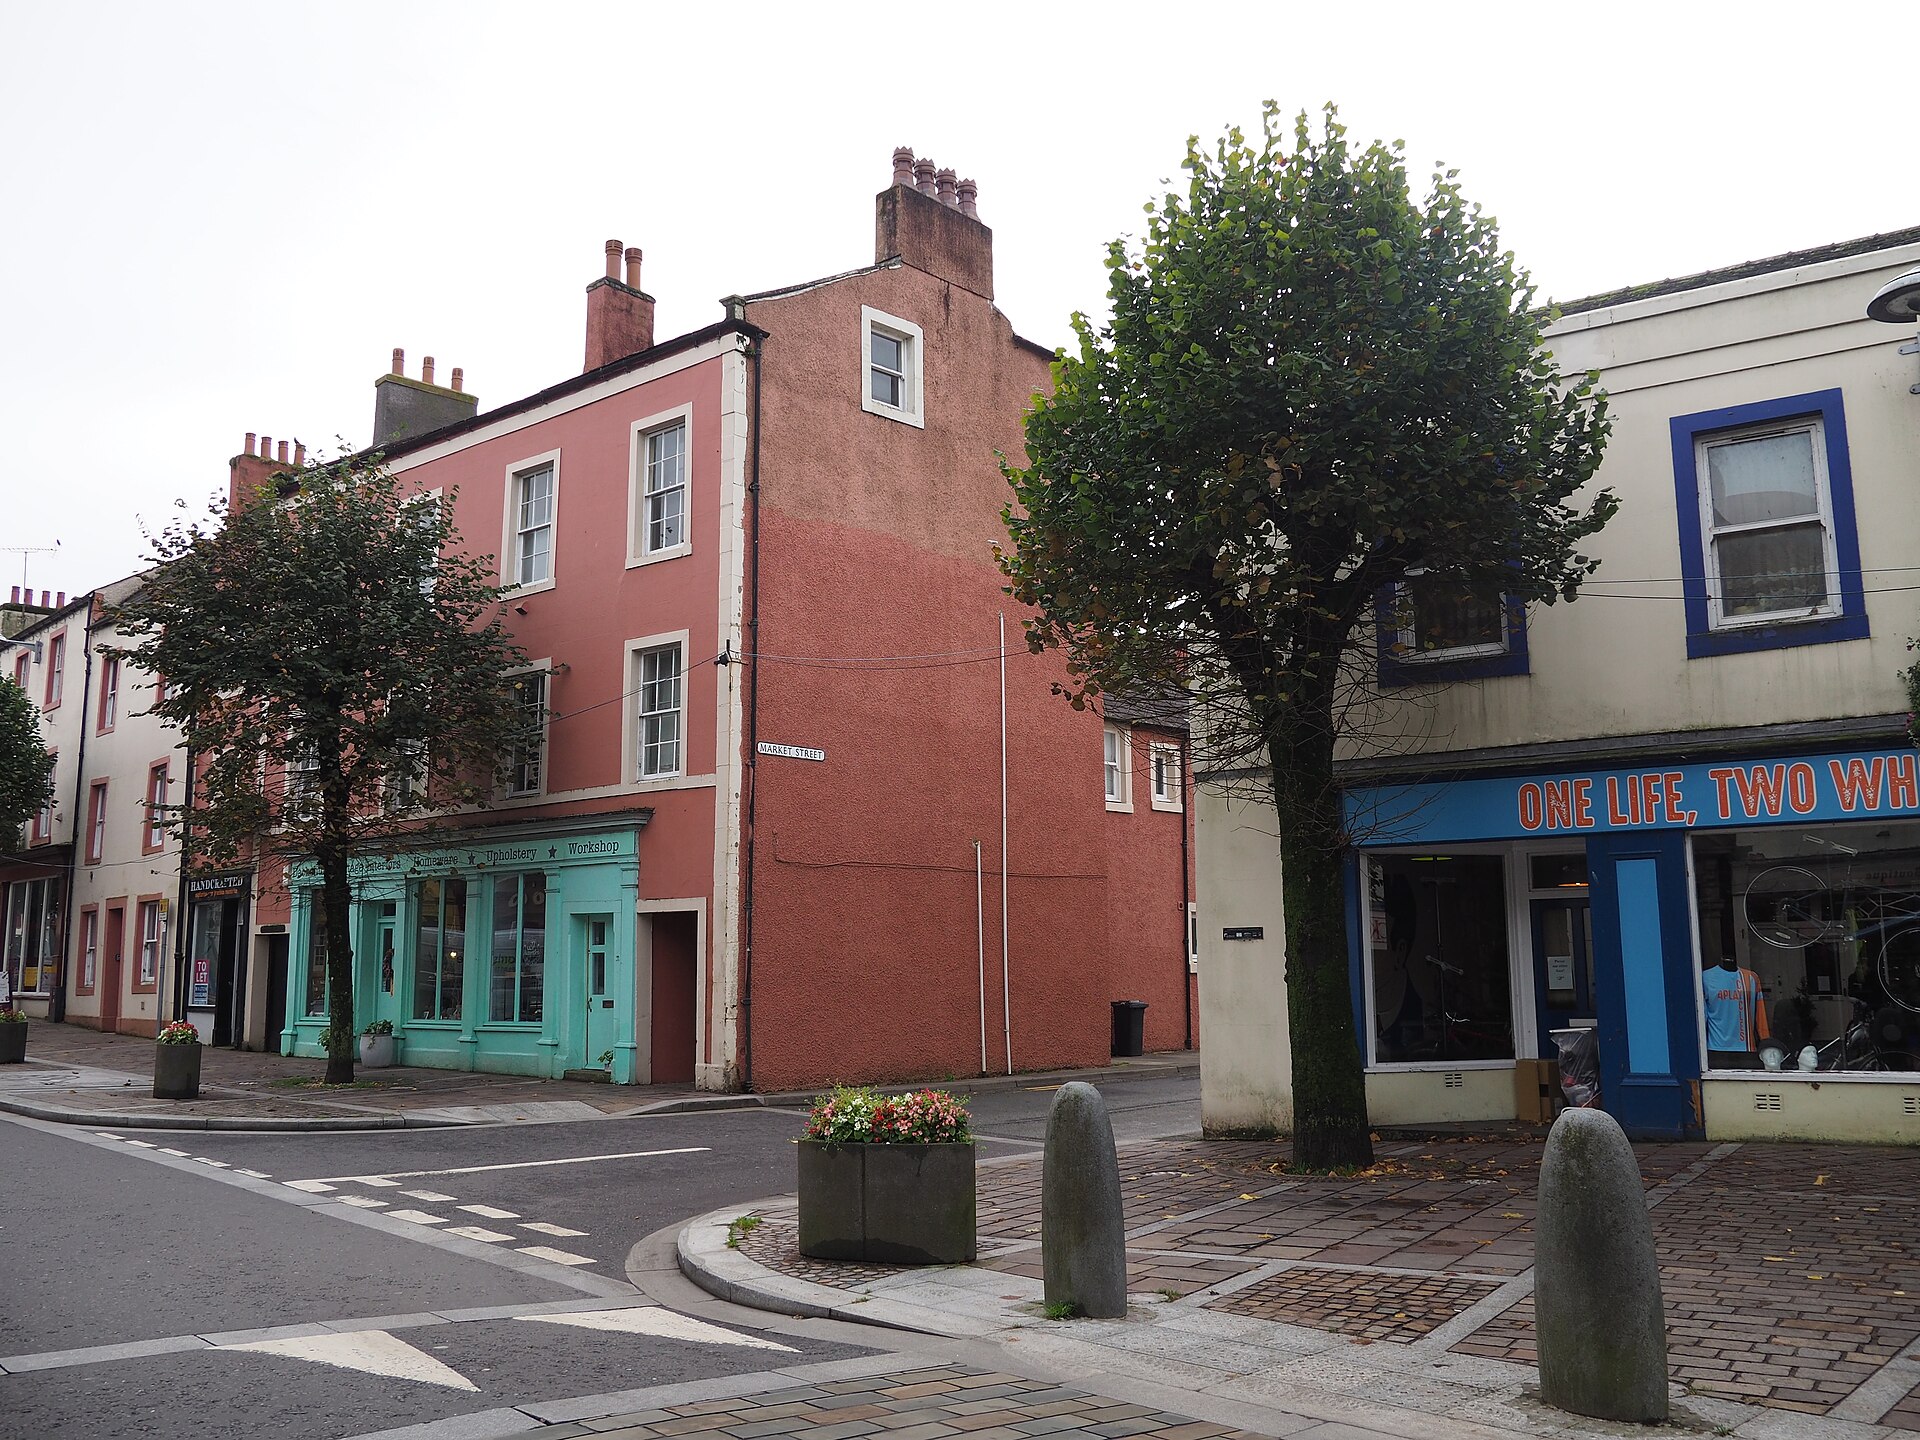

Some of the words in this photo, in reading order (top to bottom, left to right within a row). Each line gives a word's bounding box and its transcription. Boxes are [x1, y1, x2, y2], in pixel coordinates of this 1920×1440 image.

[760, 744, 792, 755] MARKET
[795, 748, 822, 759] STREET
[1518, 778, 1595, 831] ONE
[1605, 771, 1698, 827] LIFE,
[1708, 761, 1817, 820] TWO
[1827, 754, 1920, 812] WH
[486, 847, 538, 866] Upholstery
[567, 840, 620, 856] Workshop
[197, 961, 207, 972] TO
[195, 972, 208, 983] LET
